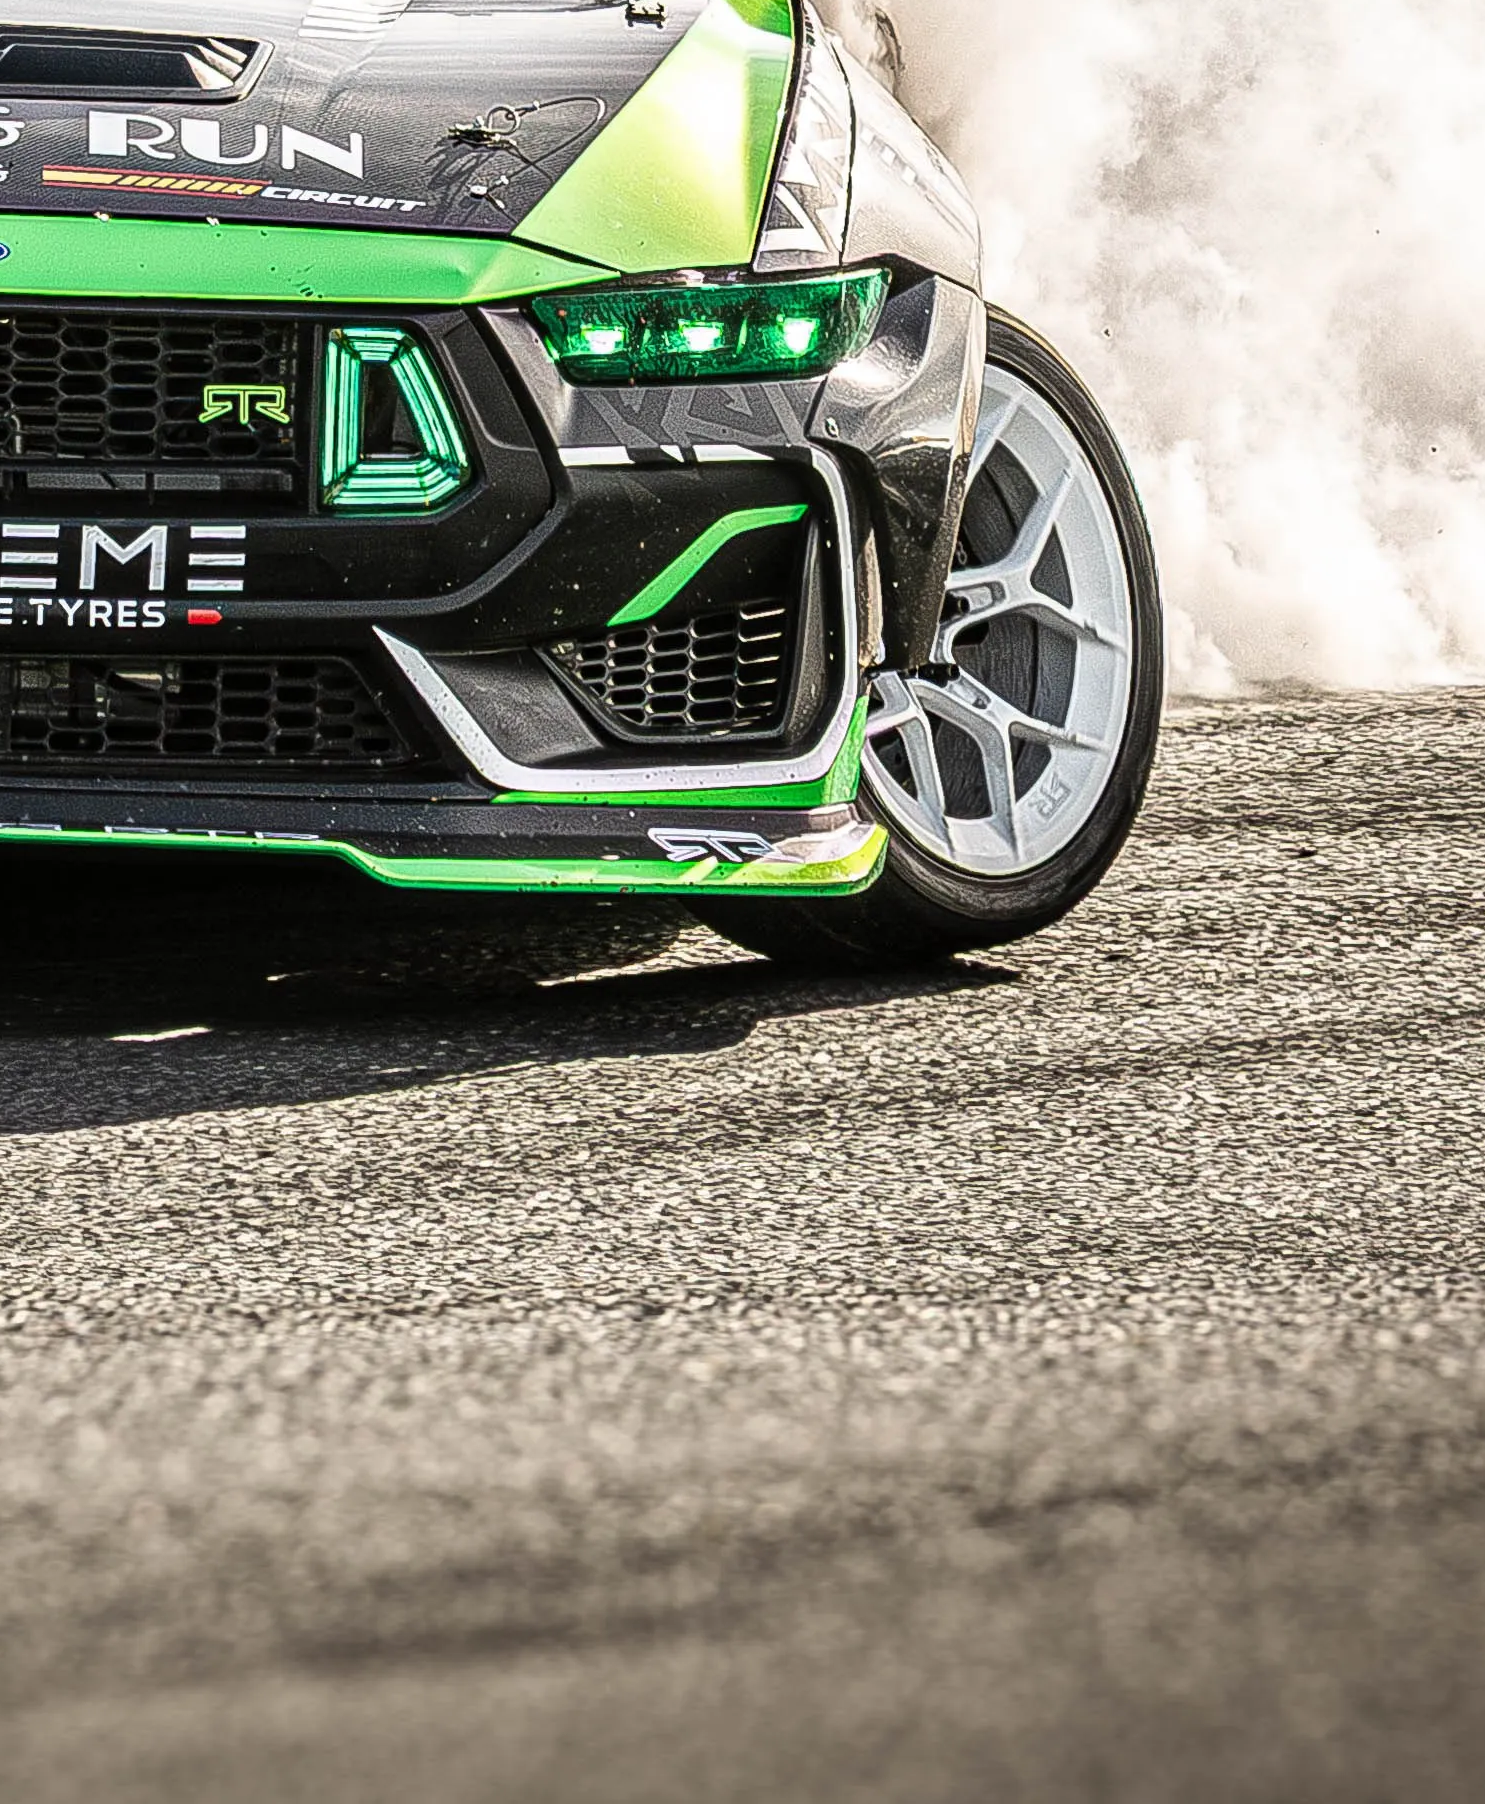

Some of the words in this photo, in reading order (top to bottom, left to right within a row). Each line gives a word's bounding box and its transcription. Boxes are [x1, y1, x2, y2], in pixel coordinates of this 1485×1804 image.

[88, 110, 364, 180] RUN
[260, 185, 428, 212] CIRCUIT
[28, 597, 167, 629] TYRES
